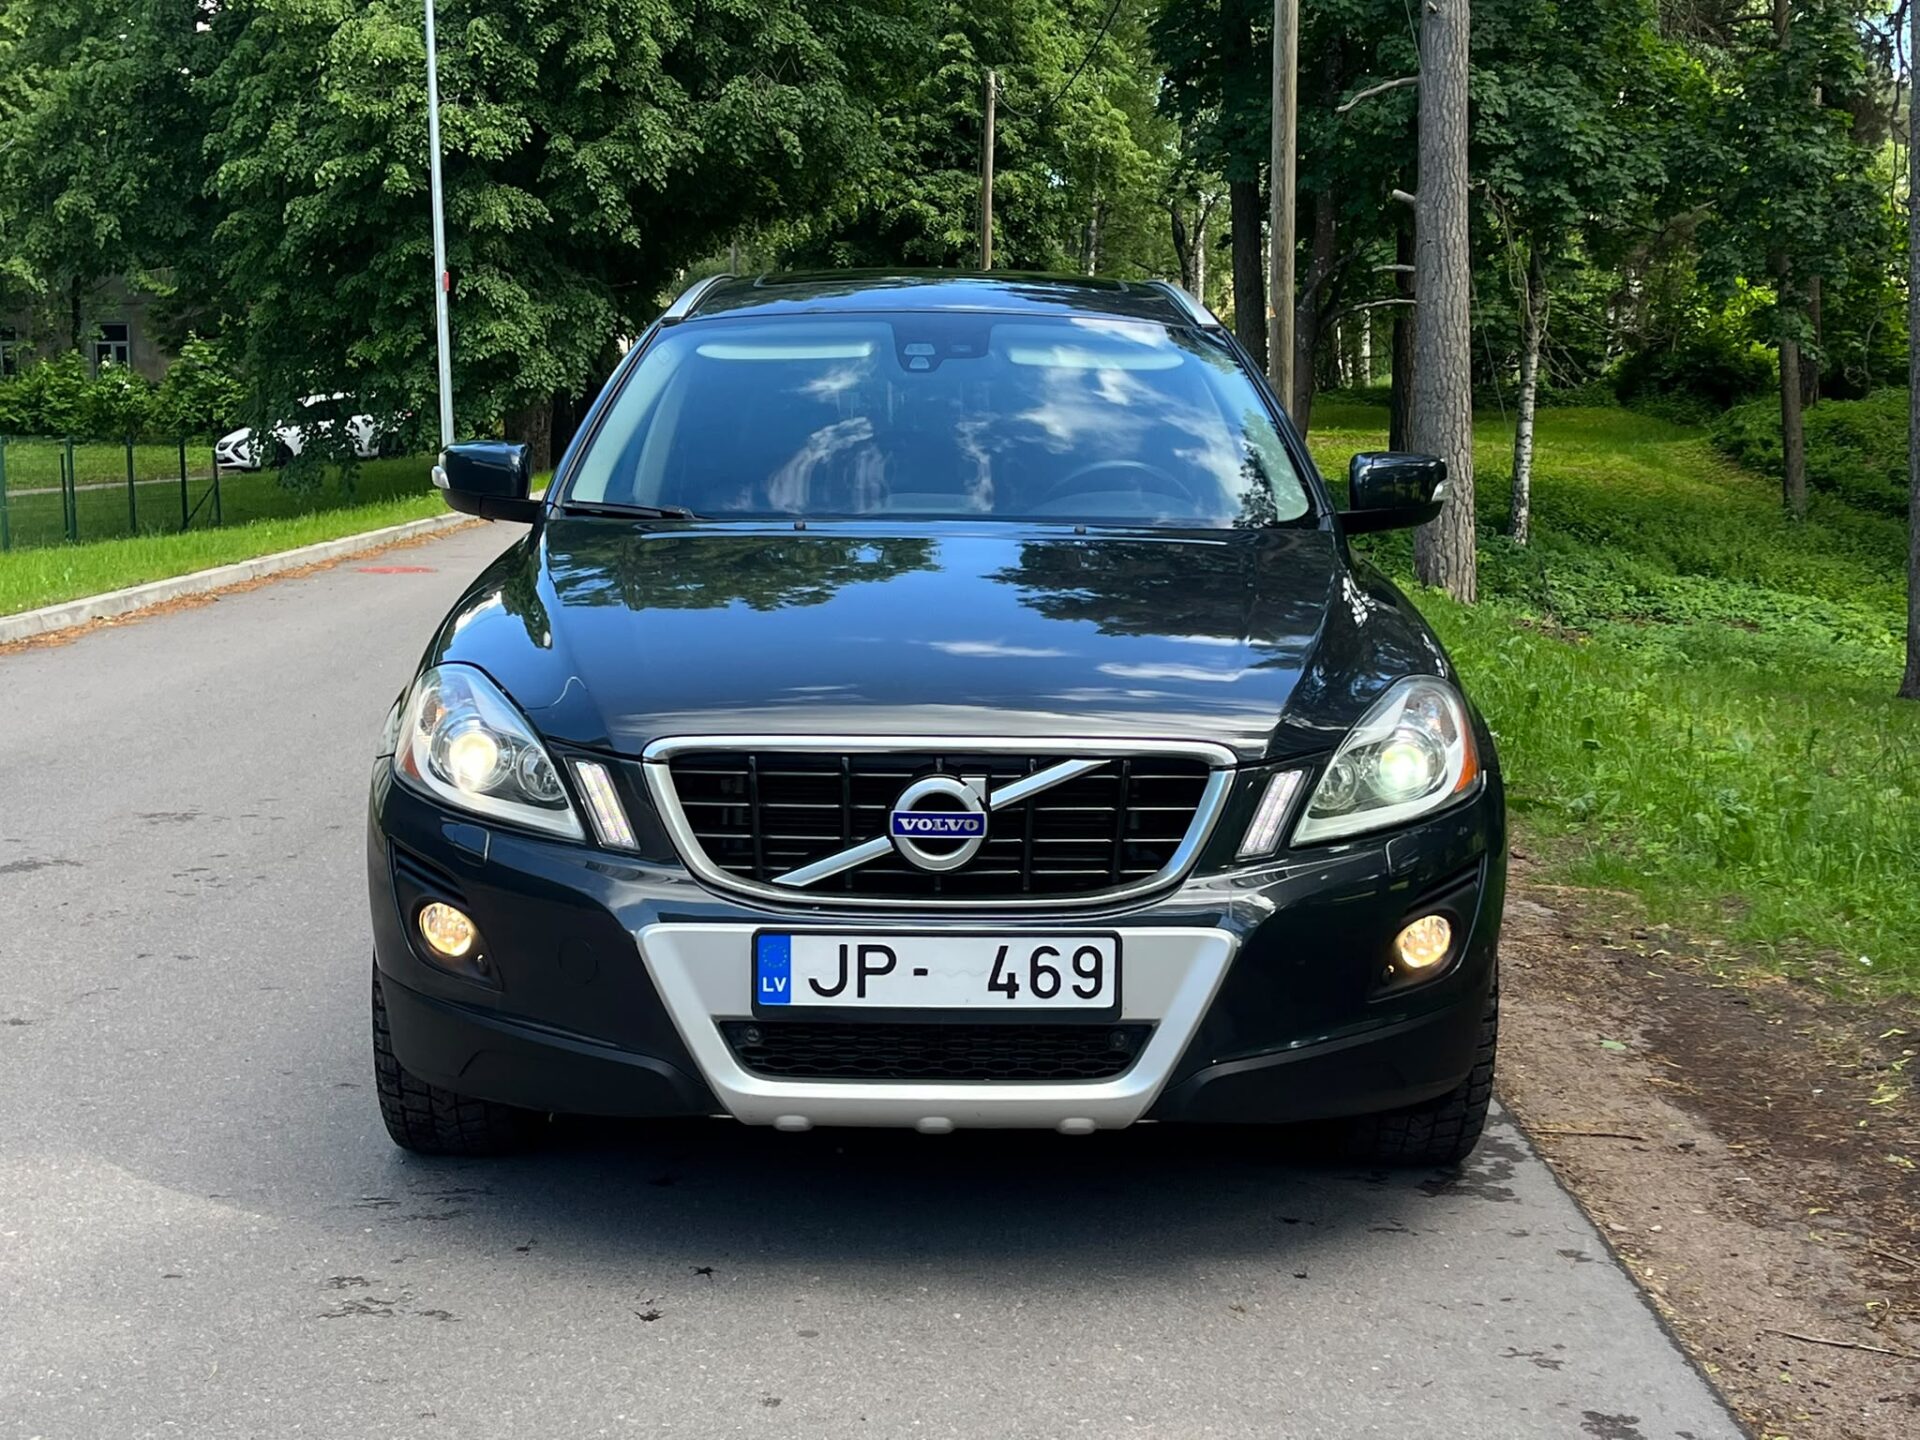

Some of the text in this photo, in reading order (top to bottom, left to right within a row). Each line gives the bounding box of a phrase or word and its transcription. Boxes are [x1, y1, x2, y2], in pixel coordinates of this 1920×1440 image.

[897, 817, 979, 832] VOLVO
[987, 945, 1103, 1000] 469
[762, 976, 787, 993] LV
